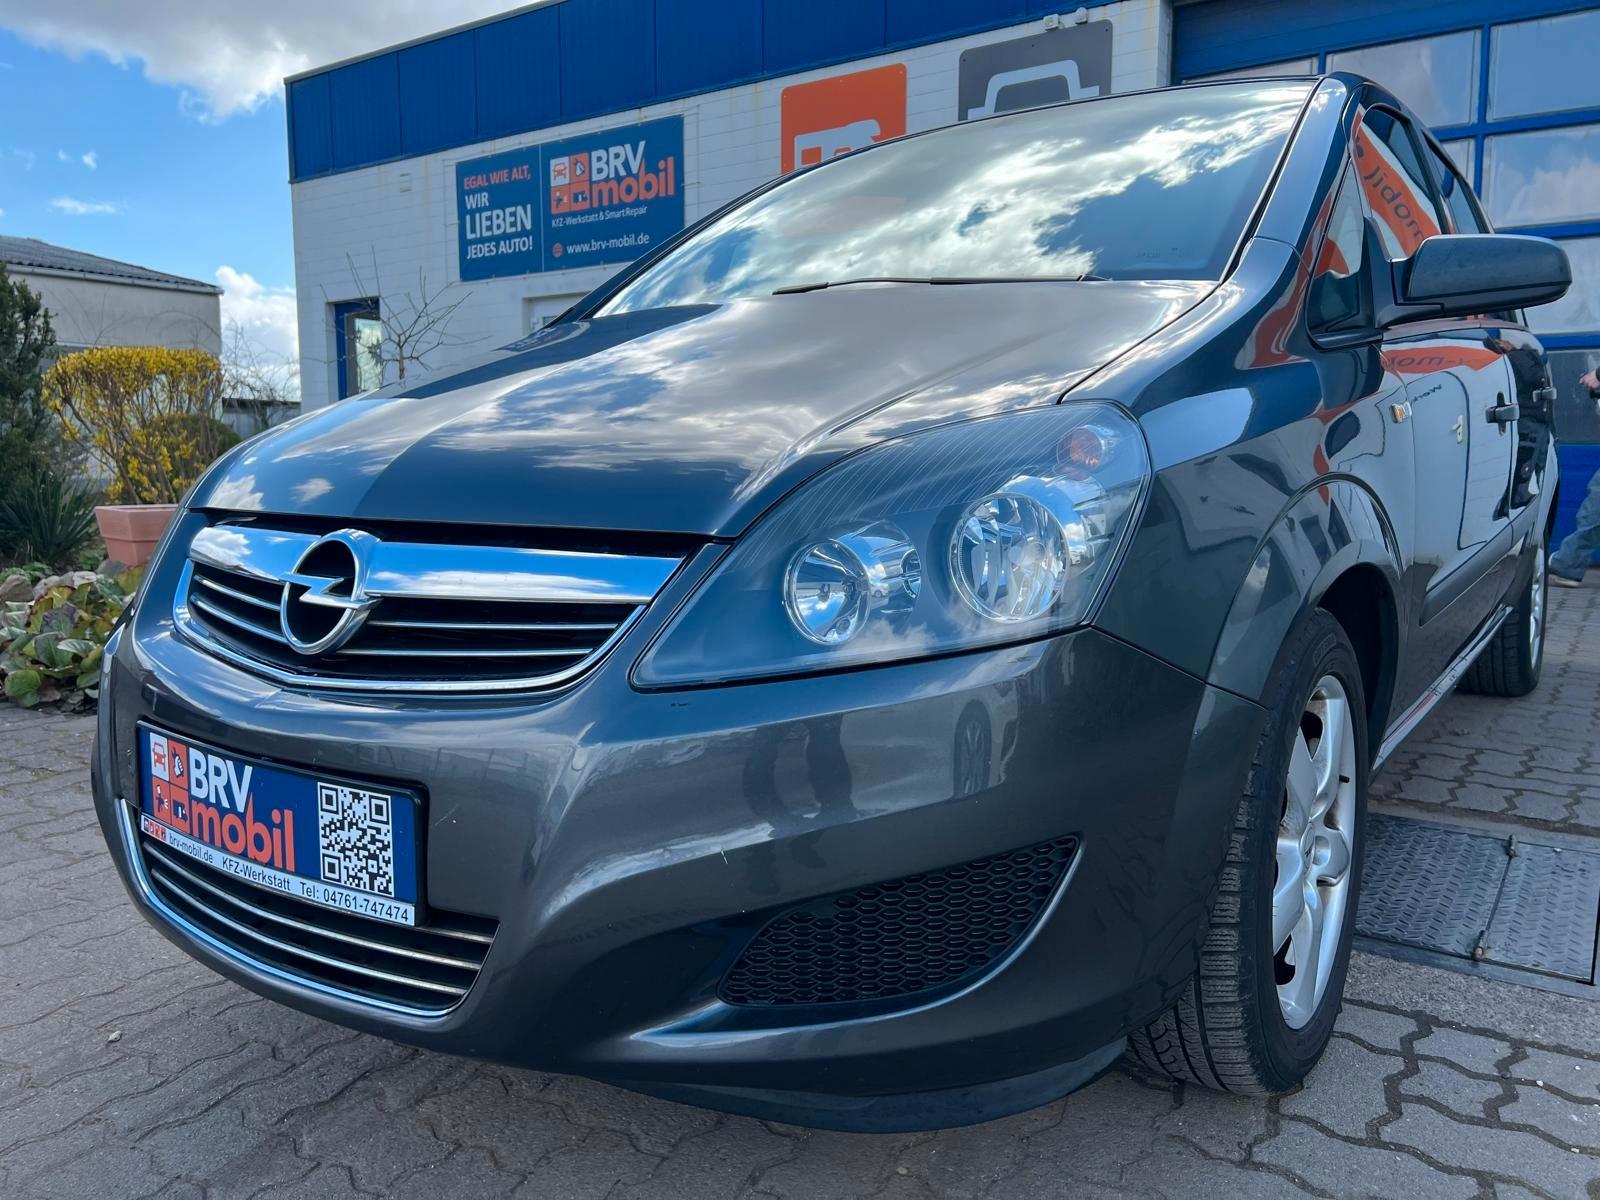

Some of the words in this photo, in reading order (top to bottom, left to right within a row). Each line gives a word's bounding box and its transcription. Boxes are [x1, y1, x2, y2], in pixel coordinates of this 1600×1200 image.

[464, 174, 488, 190] EGAL
[490, 169, 509, 185] WIE
[512, 165, 531, 180] ALT,
[591, 141, 647, 181] BRV
[592, 156, 676, 208] mobil
[465, 192, 489, 210] WIR
[605, 207, 625, 220] Smart
[625, 204, 648, 216] Repair
[466, 204, 532, 240] LIEBEN
[467, 242, 496, 260] JEDES
[498, 235, 533, 254] AUTO!
[566, 232, 650, 254] www.brv-mobil.de
[188, 747, 253, 813] BRV
[191, 792, 296, 873] mobil
[169, 832, 213, 864] brv-mobil.de
[222, 856, 291, 892] KFZ-Werkstatt
[300, 881, 320, 900] Tel:
[323, 888, 409, 923] 04761-747474
